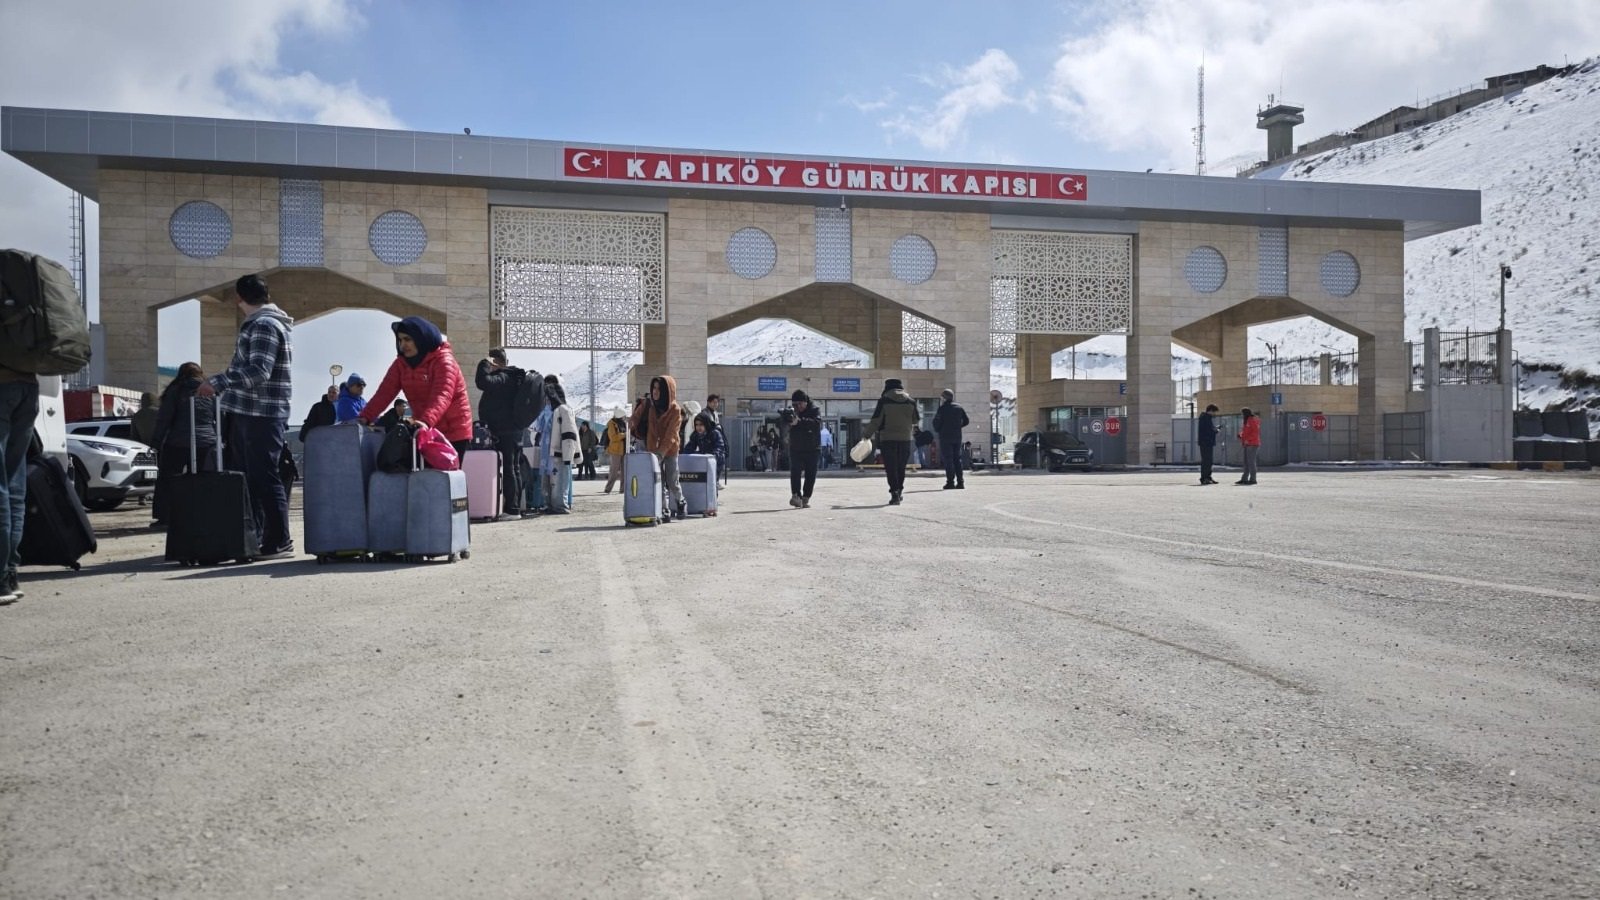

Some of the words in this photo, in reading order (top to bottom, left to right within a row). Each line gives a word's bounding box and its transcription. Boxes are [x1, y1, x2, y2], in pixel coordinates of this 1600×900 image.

[626, 158, 786, 186] KAPIKÖY
[802, 162, 930, 193] GÜMRÜK
[940, 173, 1038, 197] KAPISI
[1105, 422, 1120, 430] DUR
[1312, 419, 1326, 427] DUR
